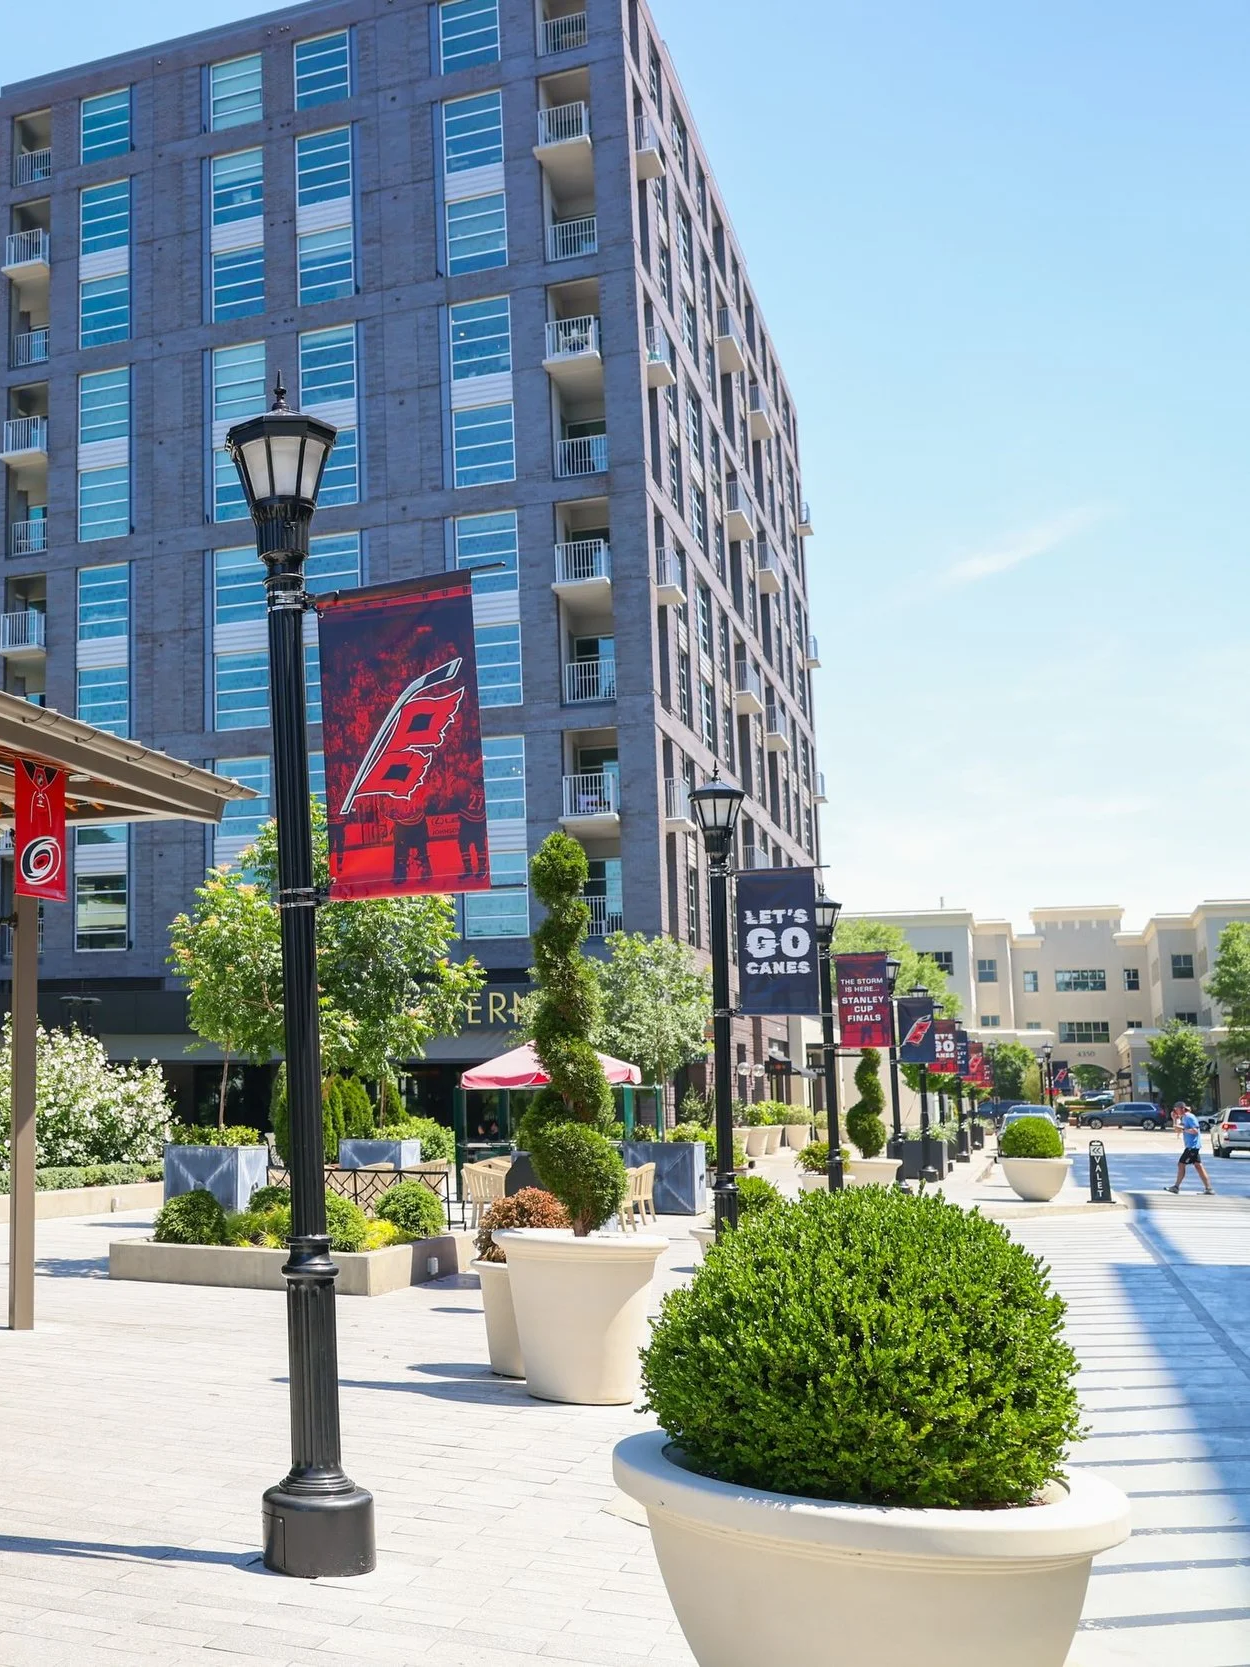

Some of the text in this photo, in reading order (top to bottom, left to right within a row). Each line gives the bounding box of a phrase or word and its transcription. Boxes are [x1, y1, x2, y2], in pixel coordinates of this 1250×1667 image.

[468, 794, 484, 811] 27
[744, 908, 810, 924] LET'S
[745, 927, 811, 958] GO
[746, 961, 812, 975] CANES
[841, 996, 884, 1004] STANLEY
[847, 1014, 881, 1022] FINALS
[1094, 1156, 1103, 1197] VALET
